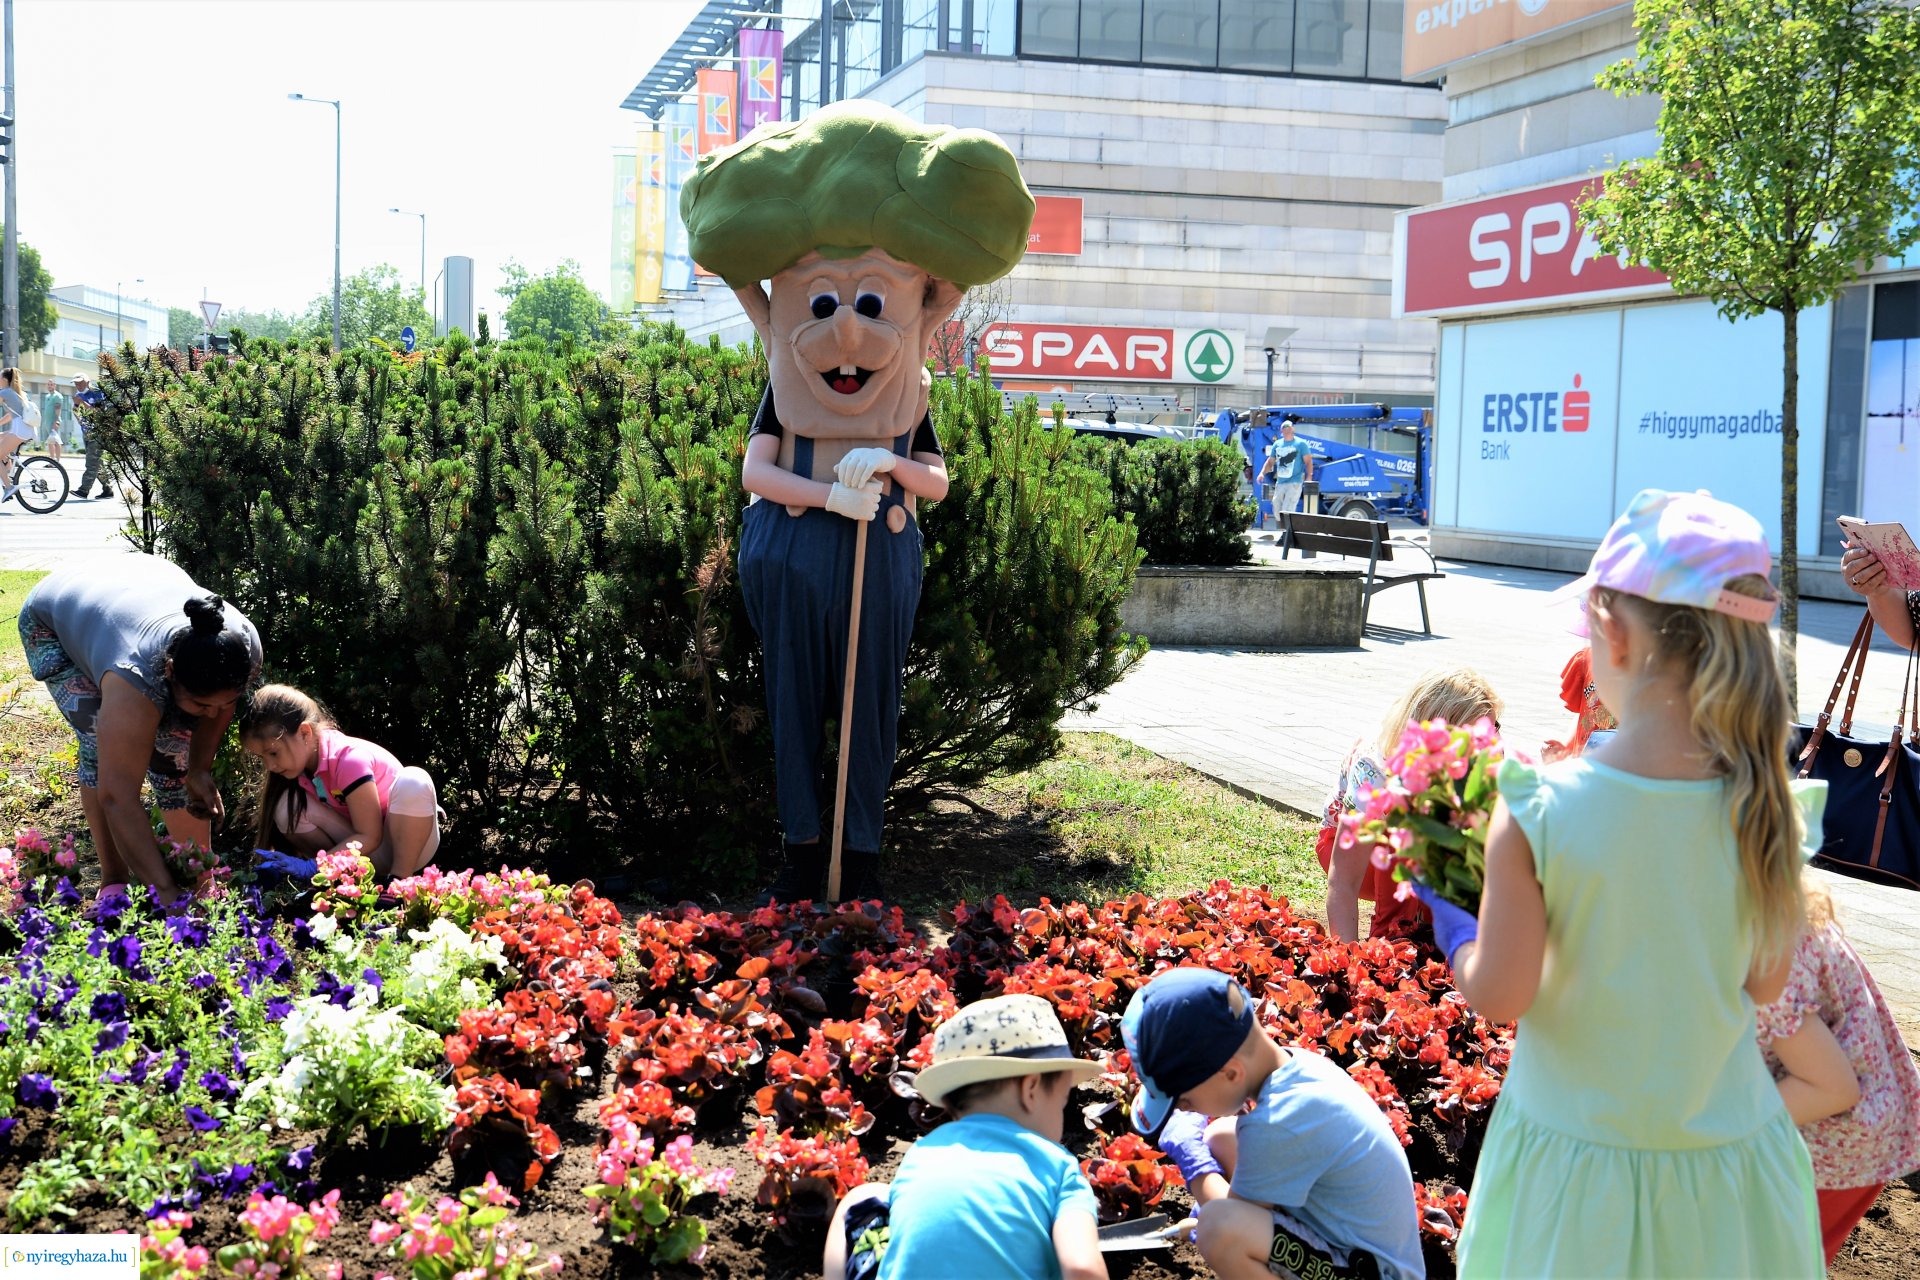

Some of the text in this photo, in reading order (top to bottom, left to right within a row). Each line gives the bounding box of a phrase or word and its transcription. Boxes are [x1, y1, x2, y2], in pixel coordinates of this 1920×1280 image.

[1415, 0, 1509, 34] expe
[620, 214, 632, 292] KORZO
[1468, 202, 1650, 289] SPA
[985, 329, 1168, 372] SPAR
[1482, 392, 1558, 432] ERSTE
[1638, 410, 1783, 439] #higgymagadba
[1481, 440, 1510, 460] Bank
